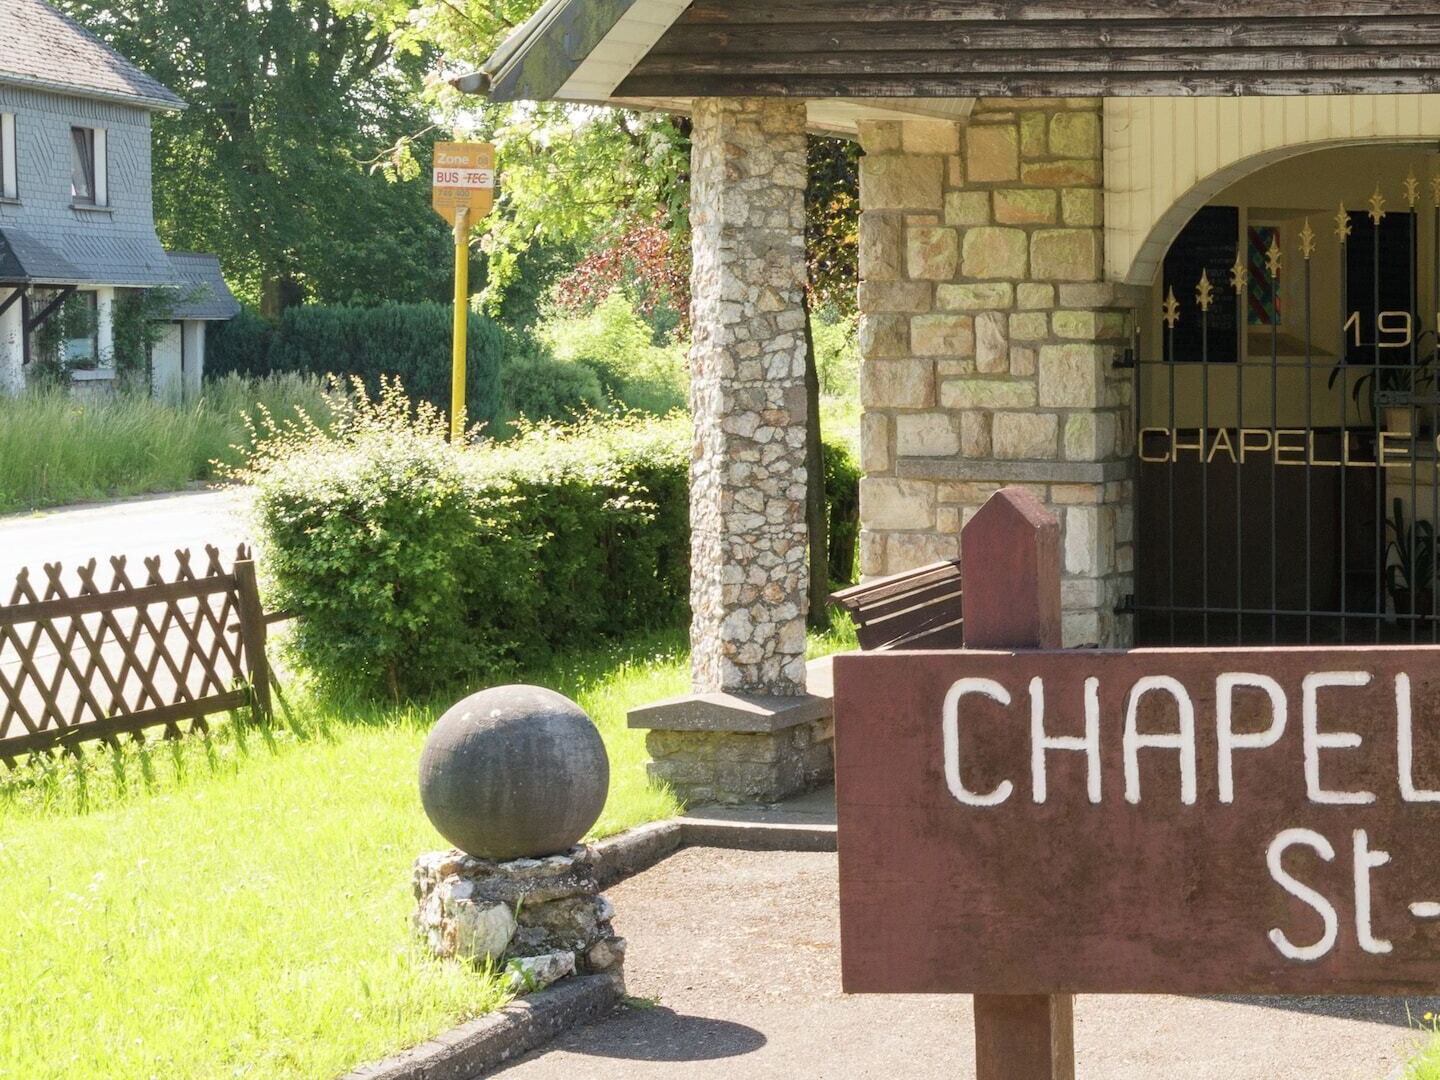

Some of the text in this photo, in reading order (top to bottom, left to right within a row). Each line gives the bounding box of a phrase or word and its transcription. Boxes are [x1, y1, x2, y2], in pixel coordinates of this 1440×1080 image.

[437, 153, 469, 165] Zone
[436, 172, 487, 184] BUS TEC
[1138, 427, 1413, 468] CHAPELLE
